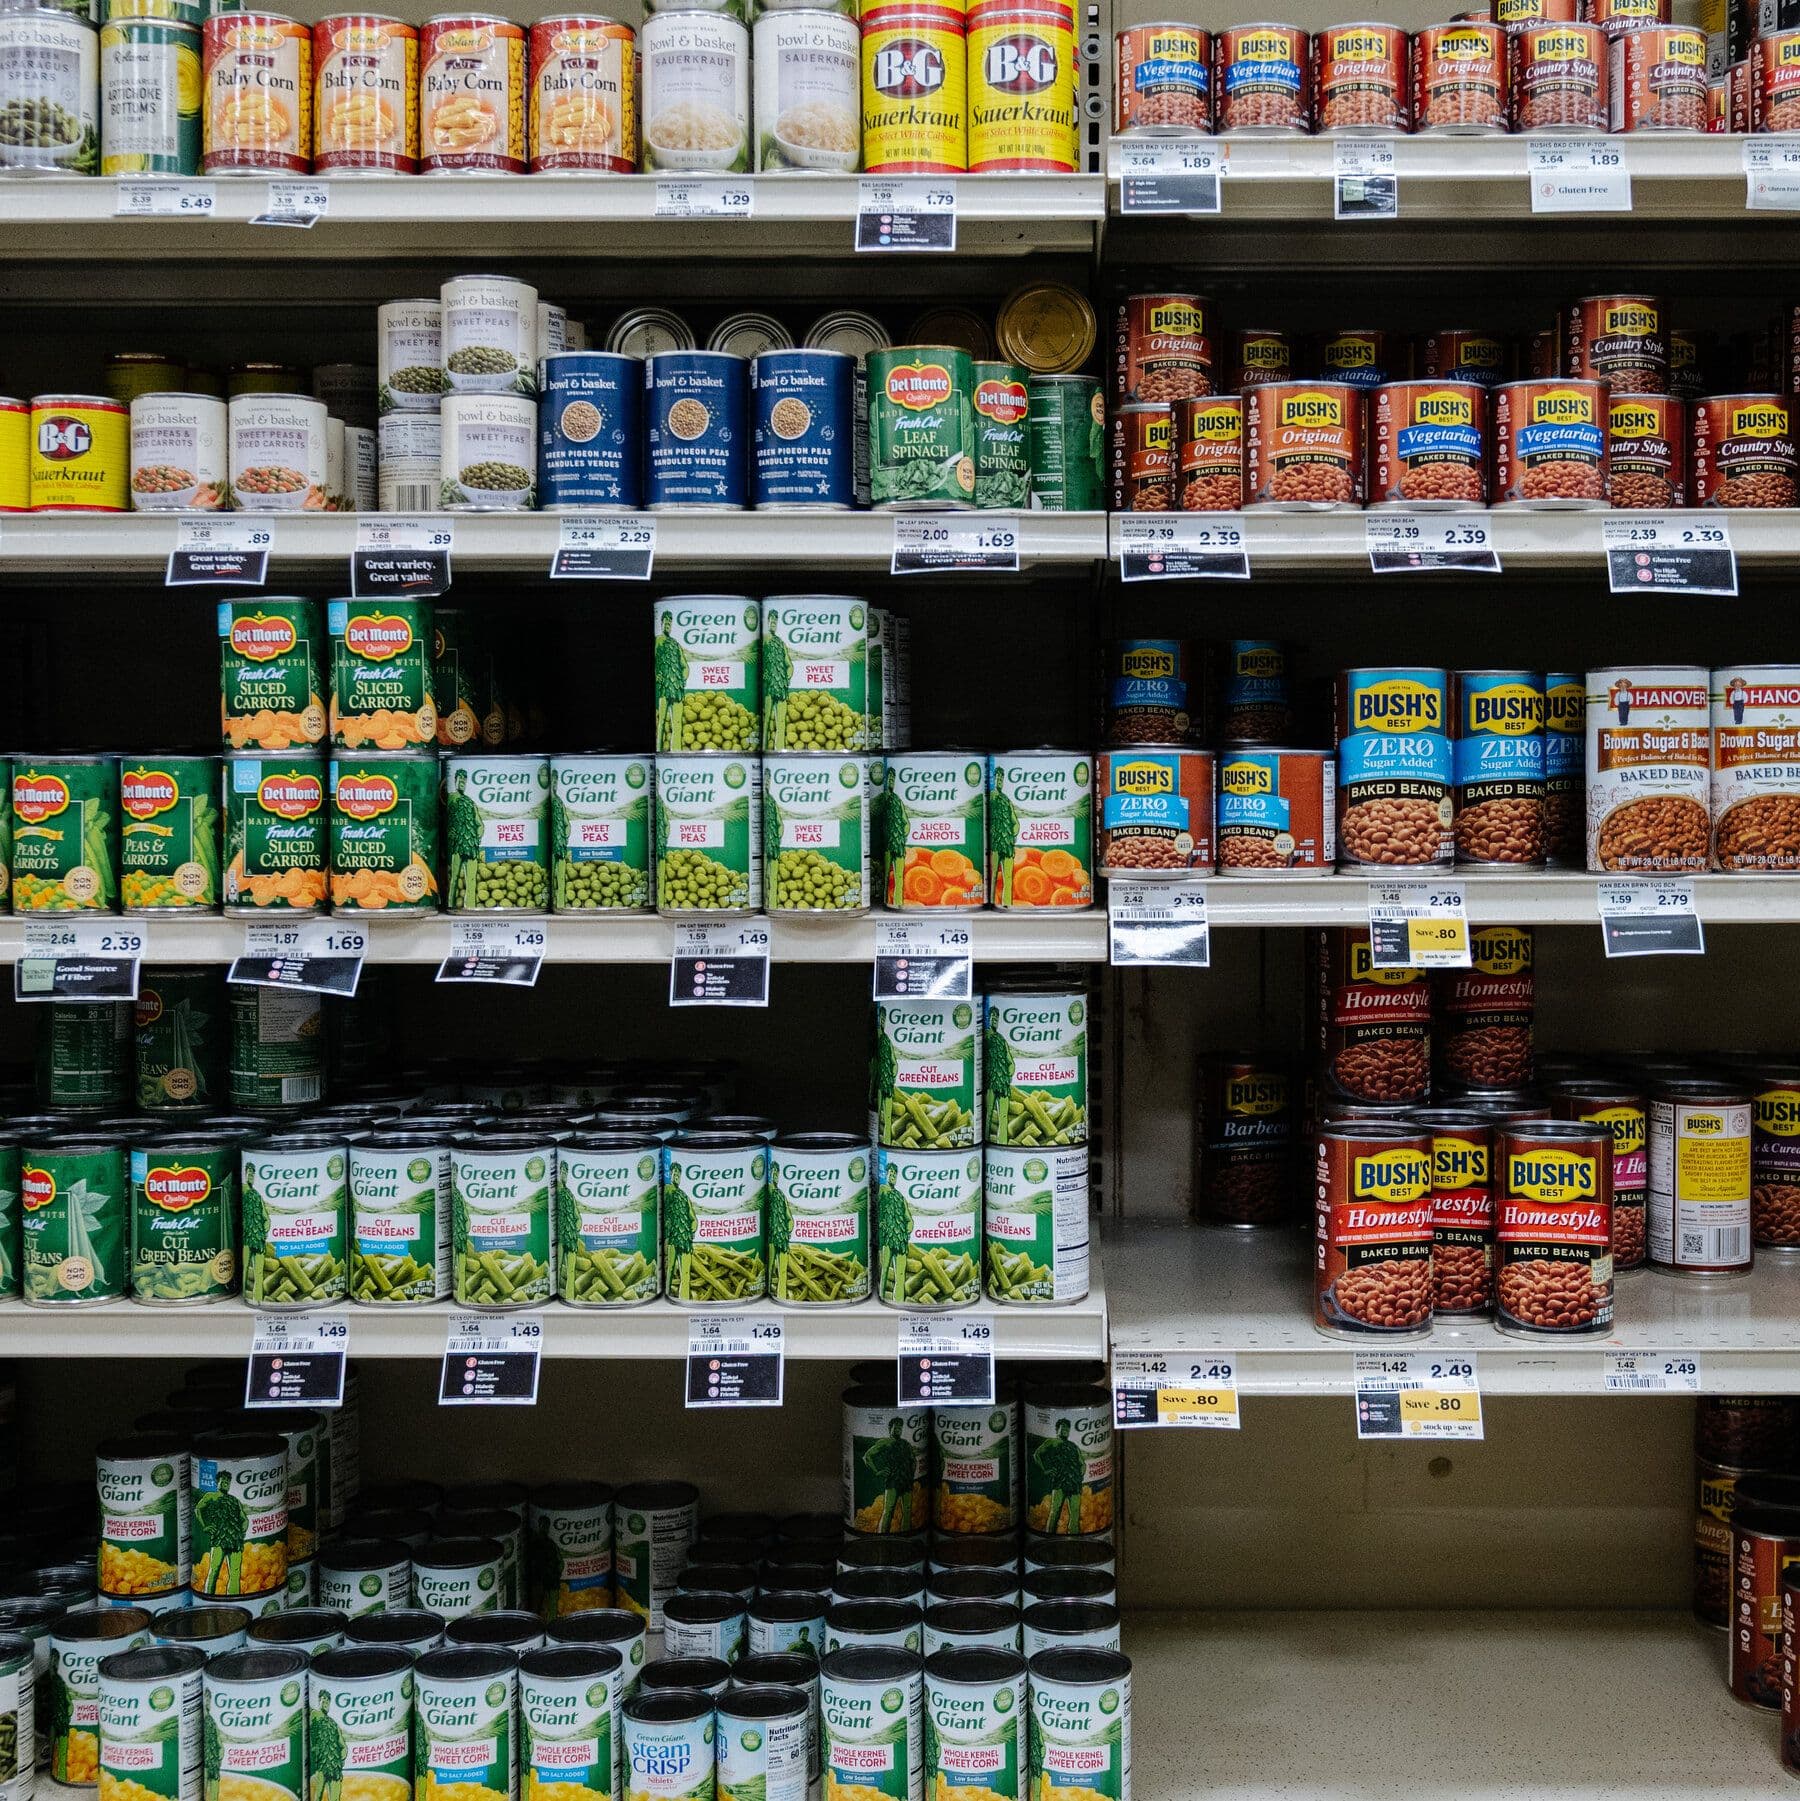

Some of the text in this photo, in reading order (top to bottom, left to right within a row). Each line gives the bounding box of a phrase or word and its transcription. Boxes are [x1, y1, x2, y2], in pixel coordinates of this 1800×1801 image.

[649, 33, 736, 53] bowl & basket
[1153, 38, 1197, 56] BUSH'S
[1538, 37, 1585, 54] BUSH'S
[655, 55, 731, 68] SAUERKRAUT
[876, 47, 943, 89] B&G
[1143, 62, 1205, 80] Vegetarian
[1525, 62, 1595, 79] Country Style
[217, 70, 294, 93] Baby Corn
[107, 88, 162, 102] ARTICHOKE
[110, 102, 156, 115] BOTTOMS
[864, 101, 961, 129] Sauerkraut
[1131, 157, 1156, 166] 3.64
[1182, 157, 1211, 168] 1.89
[1539, 155, 1563, 164] 3.64
[1590, 154, 1619, 166] 1.89
[1558, 185, 1608, 194] Gluten Free
[180, 198, 213, 209] 5.49
[303, 195, 327, 205] 2.99
[721, 194, 750, 206] 1.29
[925, 194, 954, 206] 1.79
[890, 377, 948, 392] Del Monte
[906, 393, 931, 402] Quality
[1286, 403, 1338, 419] BUSH'S
[1419, 400, 1469, 418] BUSH'S
[904, 431, 937, 444] LEAF
[1281, 430, 1342, 445] Original
[1407, 429, 1477, 445] Vegetarian
[1525, 428, 1598, 444] Vegetarian
[237, 441, 306, 451] DICED CARROTS
[892, 445, 949, 458] SPINACH
[653, 448, 729, 457] GREEN PIGEON PEAS
[654, 458, 726, 466] GANDULES VERDES
[1285, 455, 1338, 464] BAKED BEANS
[248, 533, 270, 545] .89
[571, 531, 595, 540] 2.44
[620, 532, 651, 542] 2.29
[923, 529, 949, 540] 2.00
[976, 533, 1014, 547] 1.69
[1200, 532, 1240, 545] 2.39
[1683, 531, 1724, 542] 2.39
[365, 561, 436, 572] Great variety.
[369, 572, 433, 582] Great value.
[356, 681, 403, 696] SLICED
[349, 695, 411, 709] CARROTS
[1636, 691, 1706, 705] HANOVER
[1359, 693, 1437, 721] BUSH'S
[1604, 733, 1689, 752] Brown Sugar &
[1363, 757, 1433, 770] Sugar Added
[471, 768, 531, 785] Green
[1620, 769, 1703, 782] BAKED BEANS
[478, 787, 532, 803] Giant
[1351, 784, 1442, 798] BAKED BEANS
[921, 823, 951, 831] SLICED
[498, 833, 524, 842] PEAS
[912, 831, 960, 840] CARROTS
[125, 838, 165, 853] PEAS &
[1174, 897, 1204, 908] 2.39
[1430, 896, 1461, 906] 2.49
[1659, 895, 1688, 905] 2.79
[51, 933, 76, 945] 2.64
[101, 936, 141, 951] 2.39
[274, 934, 299, 944] 1.87
[326, 936, 364, 950] 1.69
[515, 934, 543, 945] 1.49
[939, 934, 968, 944] 1.49
[56, 964, 117, 973] Good Source
[55, 973, 94, 981] of Fiber
[1687, 1119, 1720, 1130] BUSH'S
[259, 1164, 318, 1181] Green
[1513, 1162, 1592, 1190] BUSH'S
[265, 1182, 320, 1198] Giant
[700, 1216, 757, 1228] FRENCH STYLE
[1503, 1205, 1601, 1231] Homestyle
[700, 1225, 757, 1237] GREEN BEANS
[162, 1236, 190, 1249] CUT
[140, 1248, 216, 1263] GREEN BEANS
[1513, 1246, 1591, 1259] BAKED BEANS
[318, 1326, 347, 1337] 1.49
[752, 1327, 781, 1339] 1.49
[961, 1327, 990, 1339] 1.49
[1141, 1362, 1167, 1372] 1.42
[1191, 1365, 1232, 1379] 2.49
[1431, 1364, 1472, 1378] 2.49
[1665, 1363, 1696, 1374] 2.49
[1192, 1396, 1218, 1405] .80
[1405, 1399, 1460, 1410] Save .80
[422, 1690, 476, 1708] Green
[427, 1708, 478, 1726] Giant
[769, 1723, 800, 1736] Nutrition
[769, 1733, 789, 1742] Facts
[228, 1743, 286, 1757] CREAM STYLE
[633, 1741, 691, 1758] steam
[790, 1750, 800, 1760] 60
[943, 1748, 1000, 1759] WHOLE KERNEL
[633, 1757, 691, 1776] CRISP
[943, 1758, 999, 1769] SWEET CORN
[647, 1776, 674, 1784] Niblets
[954, 1775, 988, 1783] Low Sodium
